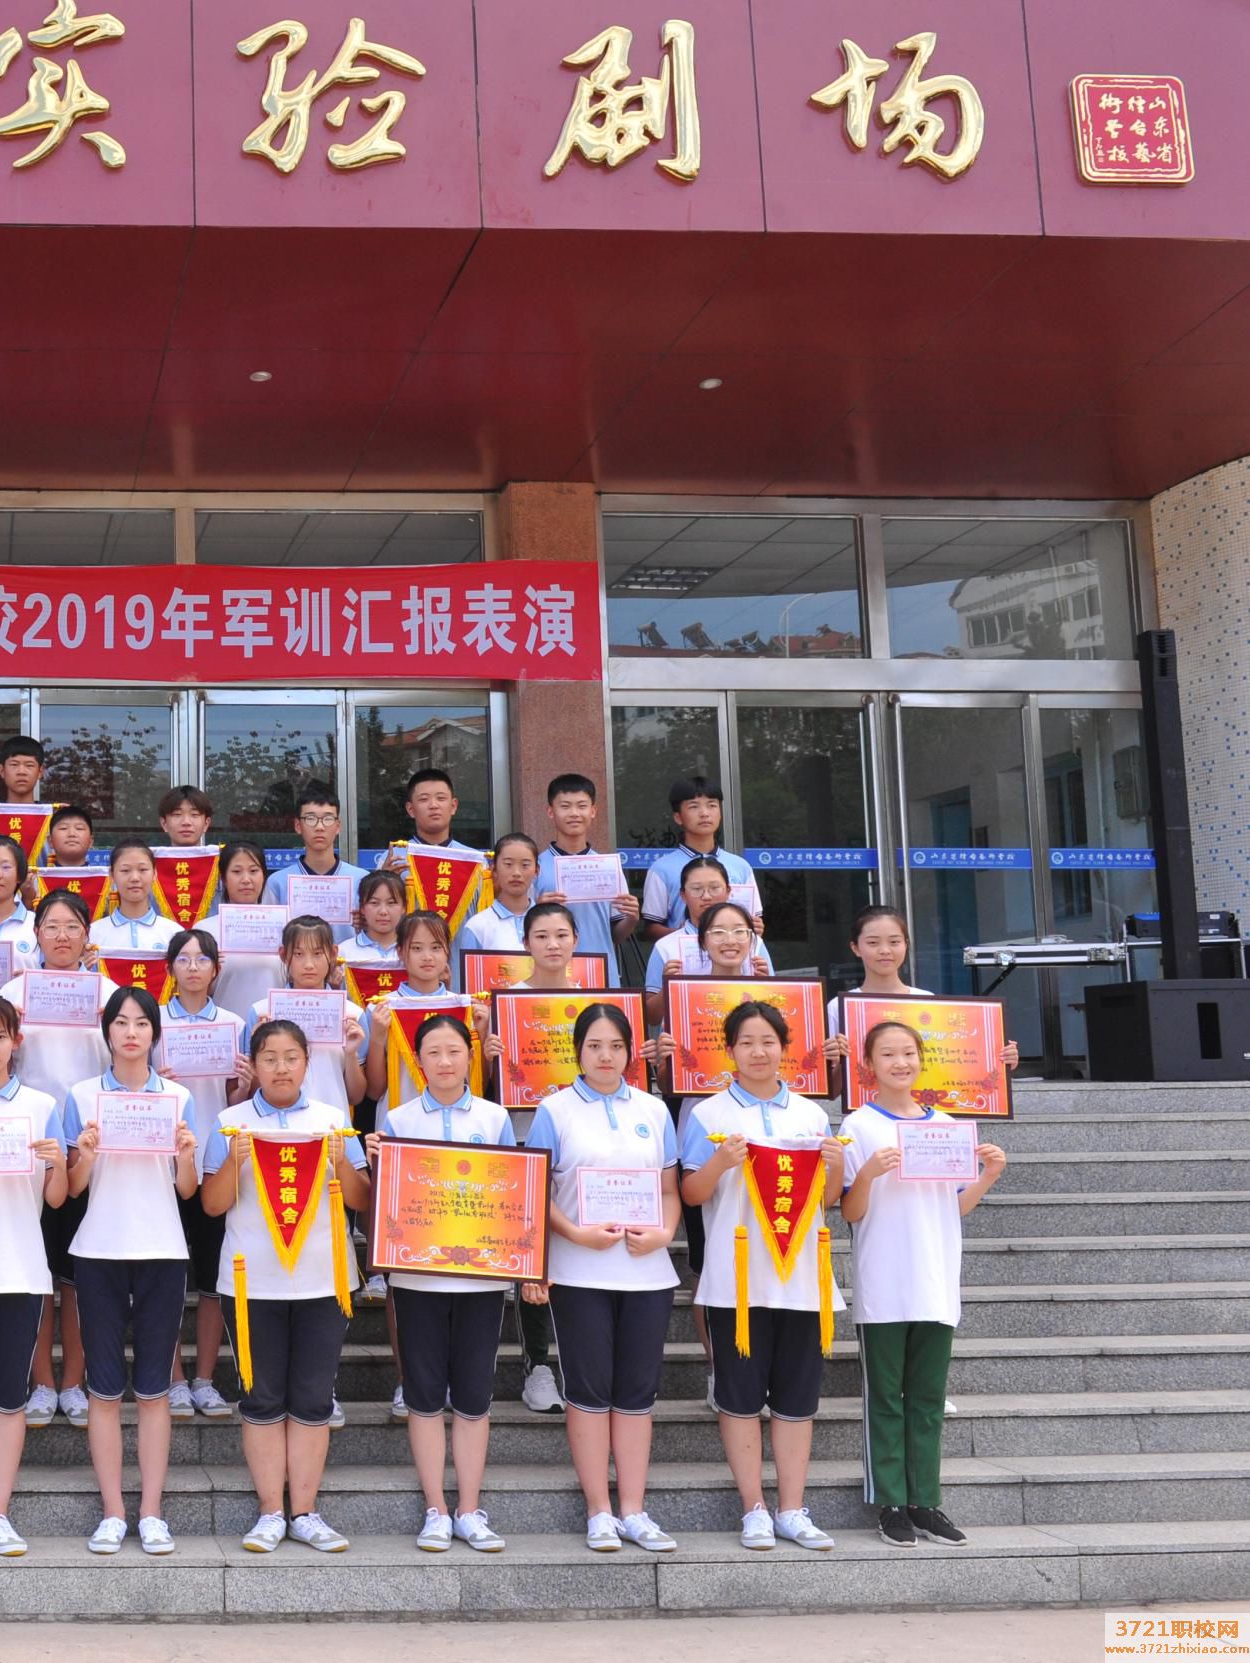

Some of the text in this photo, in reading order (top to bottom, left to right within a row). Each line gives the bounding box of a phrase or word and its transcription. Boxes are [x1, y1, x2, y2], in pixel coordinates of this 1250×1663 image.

[175, 862, 192, 922] 优秀宿舍
[279, 1147, 299, 1225] 优秀宿舍
[773, 1155, 794, 1234] 优秀宿舍
